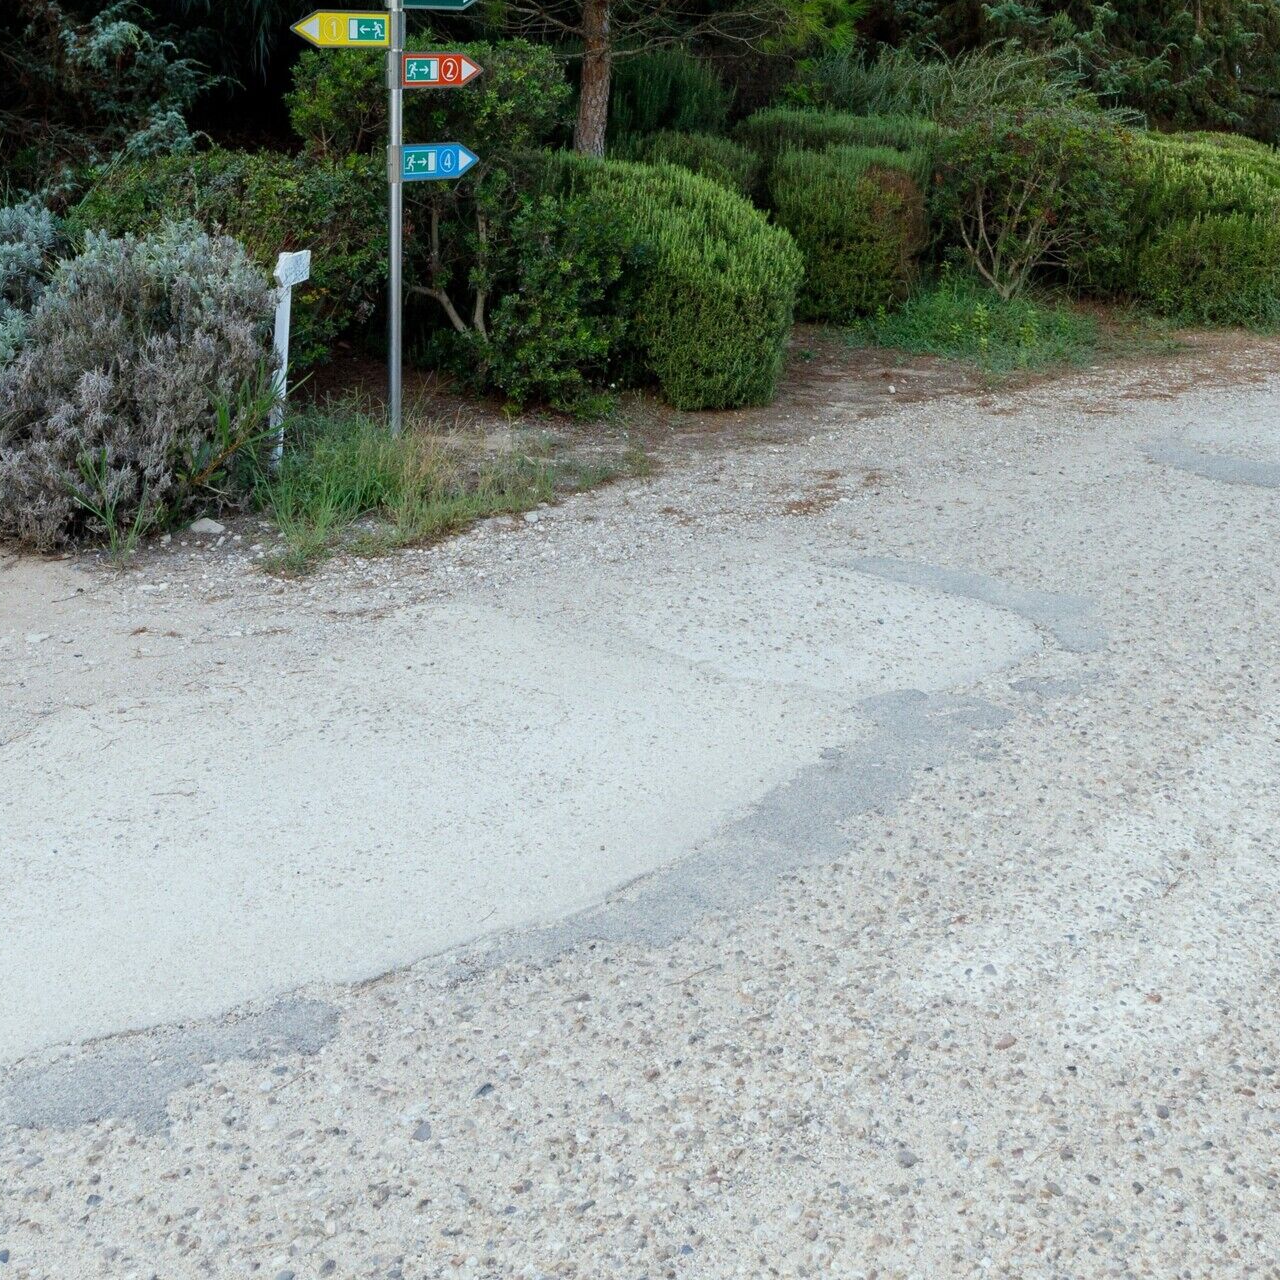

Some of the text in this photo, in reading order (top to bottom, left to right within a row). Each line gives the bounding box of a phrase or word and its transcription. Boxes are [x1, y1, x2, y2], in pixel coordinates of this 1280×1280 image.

[330, 21, 337, 37] 1
[446, 62, 454, 78] 2
[444, 153, 451, 168] 4
